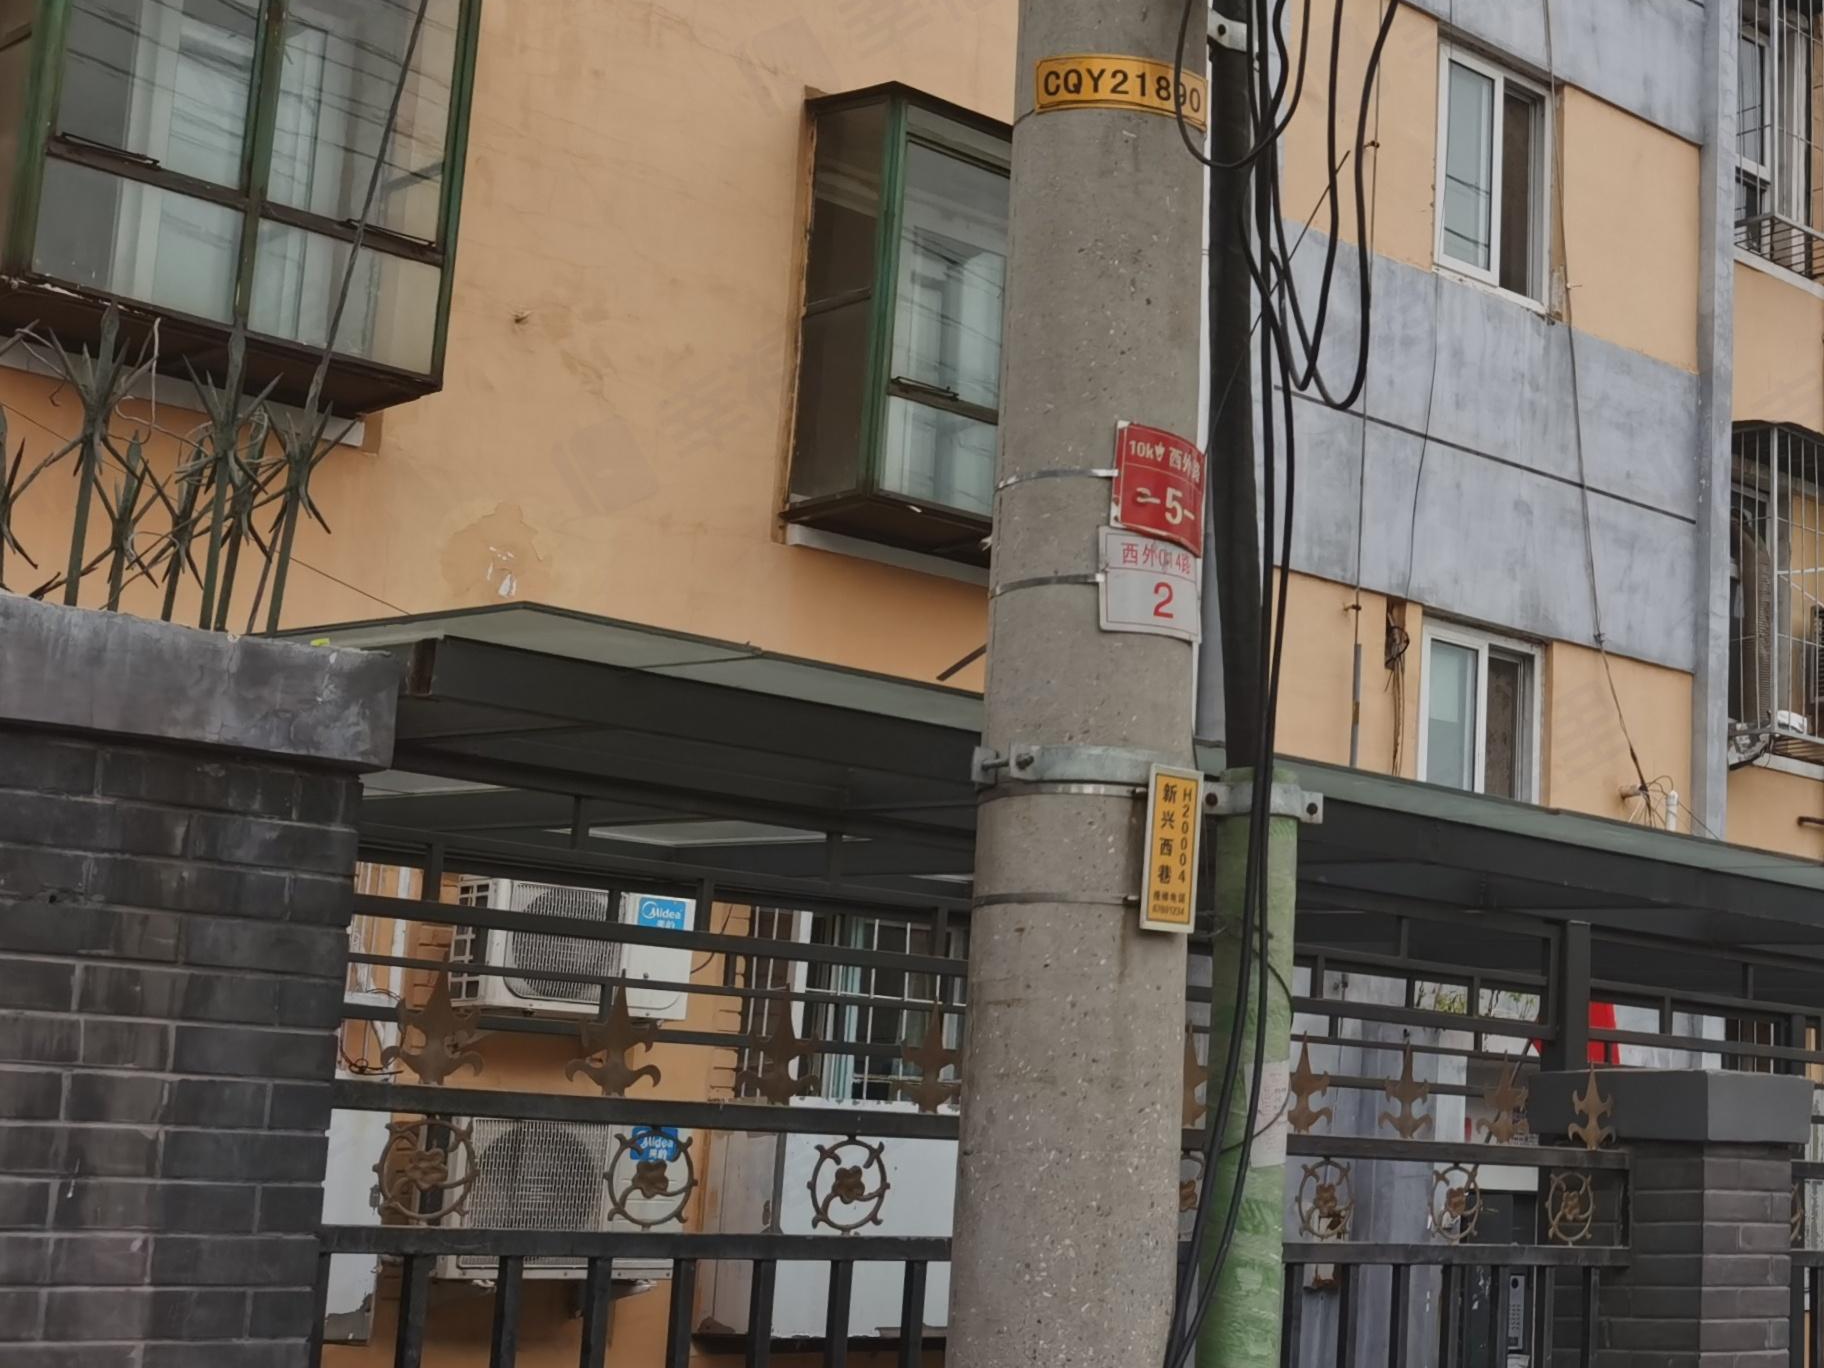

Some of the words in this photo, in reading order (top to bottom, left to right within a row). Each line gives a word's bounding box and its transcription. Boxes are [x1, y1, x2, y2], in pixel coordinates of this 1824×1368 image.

[1043, 67, 1201, 113] CQY21890
[1153, 581, 1174, 619] 2
[1157, 783, 1178, 884] 新兴西巷
[1178, 788, 1193, 884] H20004
[645, 903, 682, 920] Midea
